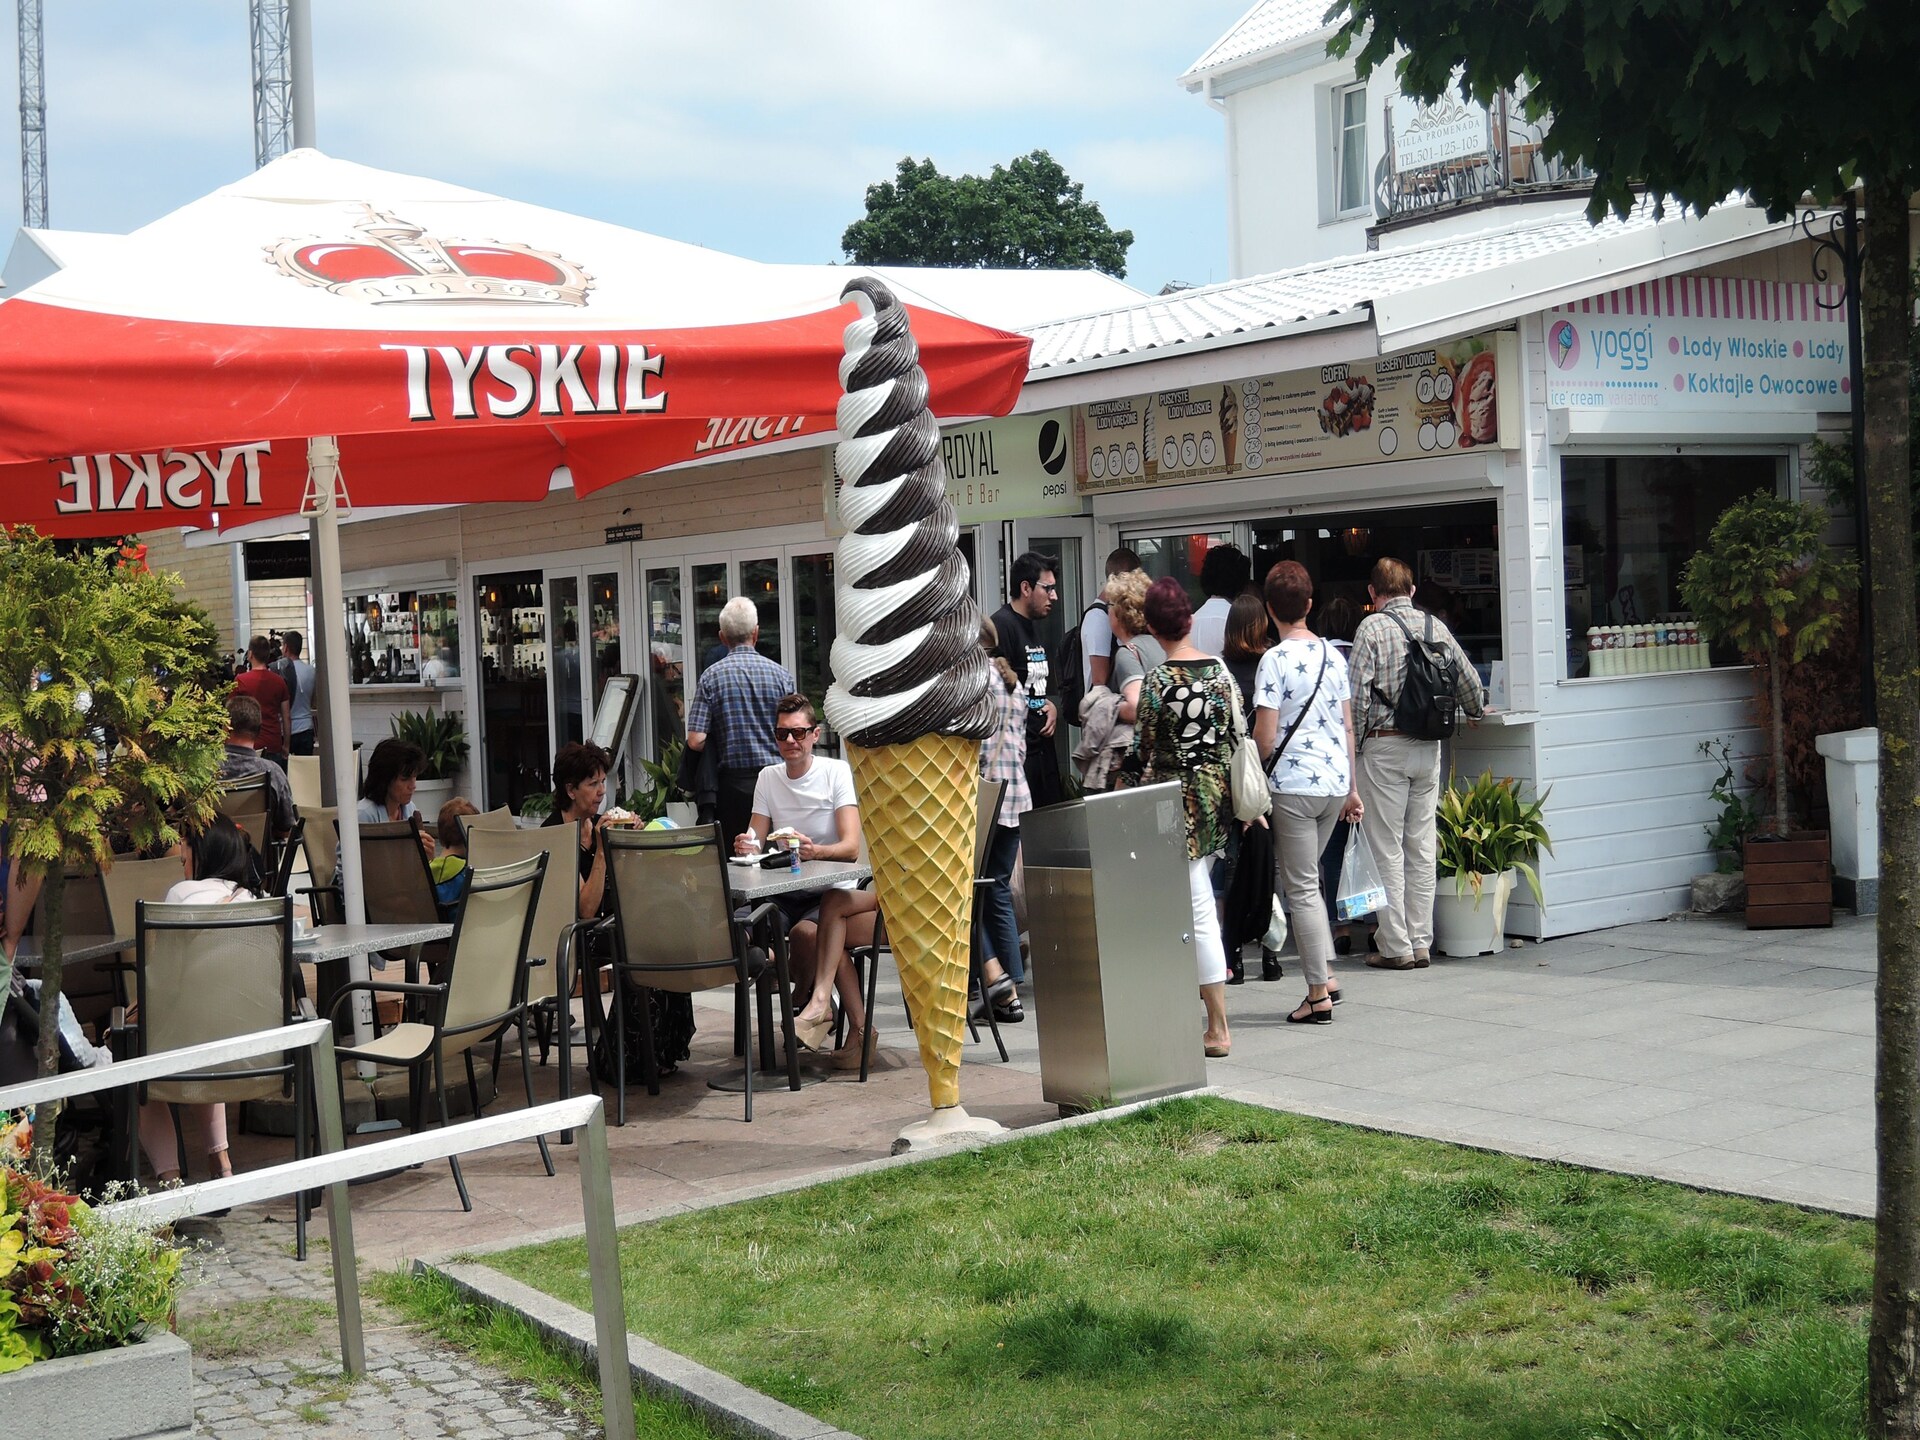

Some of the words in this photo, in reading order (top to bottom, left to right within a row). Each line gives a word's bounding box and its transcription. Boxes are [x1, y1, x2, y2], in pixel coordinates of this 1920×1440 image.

[1396, 136, 1423, 149] VILLA
[1426, 119, 1480, 142] PROMENADA
[1591, 323, 1654, 371] yoggi
[1683, 336, 1722, 361] Lody
[1728, 336, 1788, 359] Włoskie
[1808, 339, 1845, 364] Lody
[1376, 356, 1404, 374] DESERY
[1405, 350, 1436, 369] LODOWE
[380, 344, 669, 421] TYSKIE
[1321, 363, 1350, 384] GOFRY
[1688, 373, 1753, 398] Koktajle
[1759, 374, 1837, 394] Owocowe
[1159, 390, 1189, 406] PUSZYSTE
[1551, 389, 1566, 406] ice
[1570, 391, 1604, 406] cream
[1609, 391, 1659, 406] variations
[1097, 415, 1112, 430] LODY
[1168, 404, 1185, 420] LODY
[942, 430, 999, 480] ROYAL
[980, 483, 1000, 503] Bar
[1043, 481, 1067, 499] pepsi
